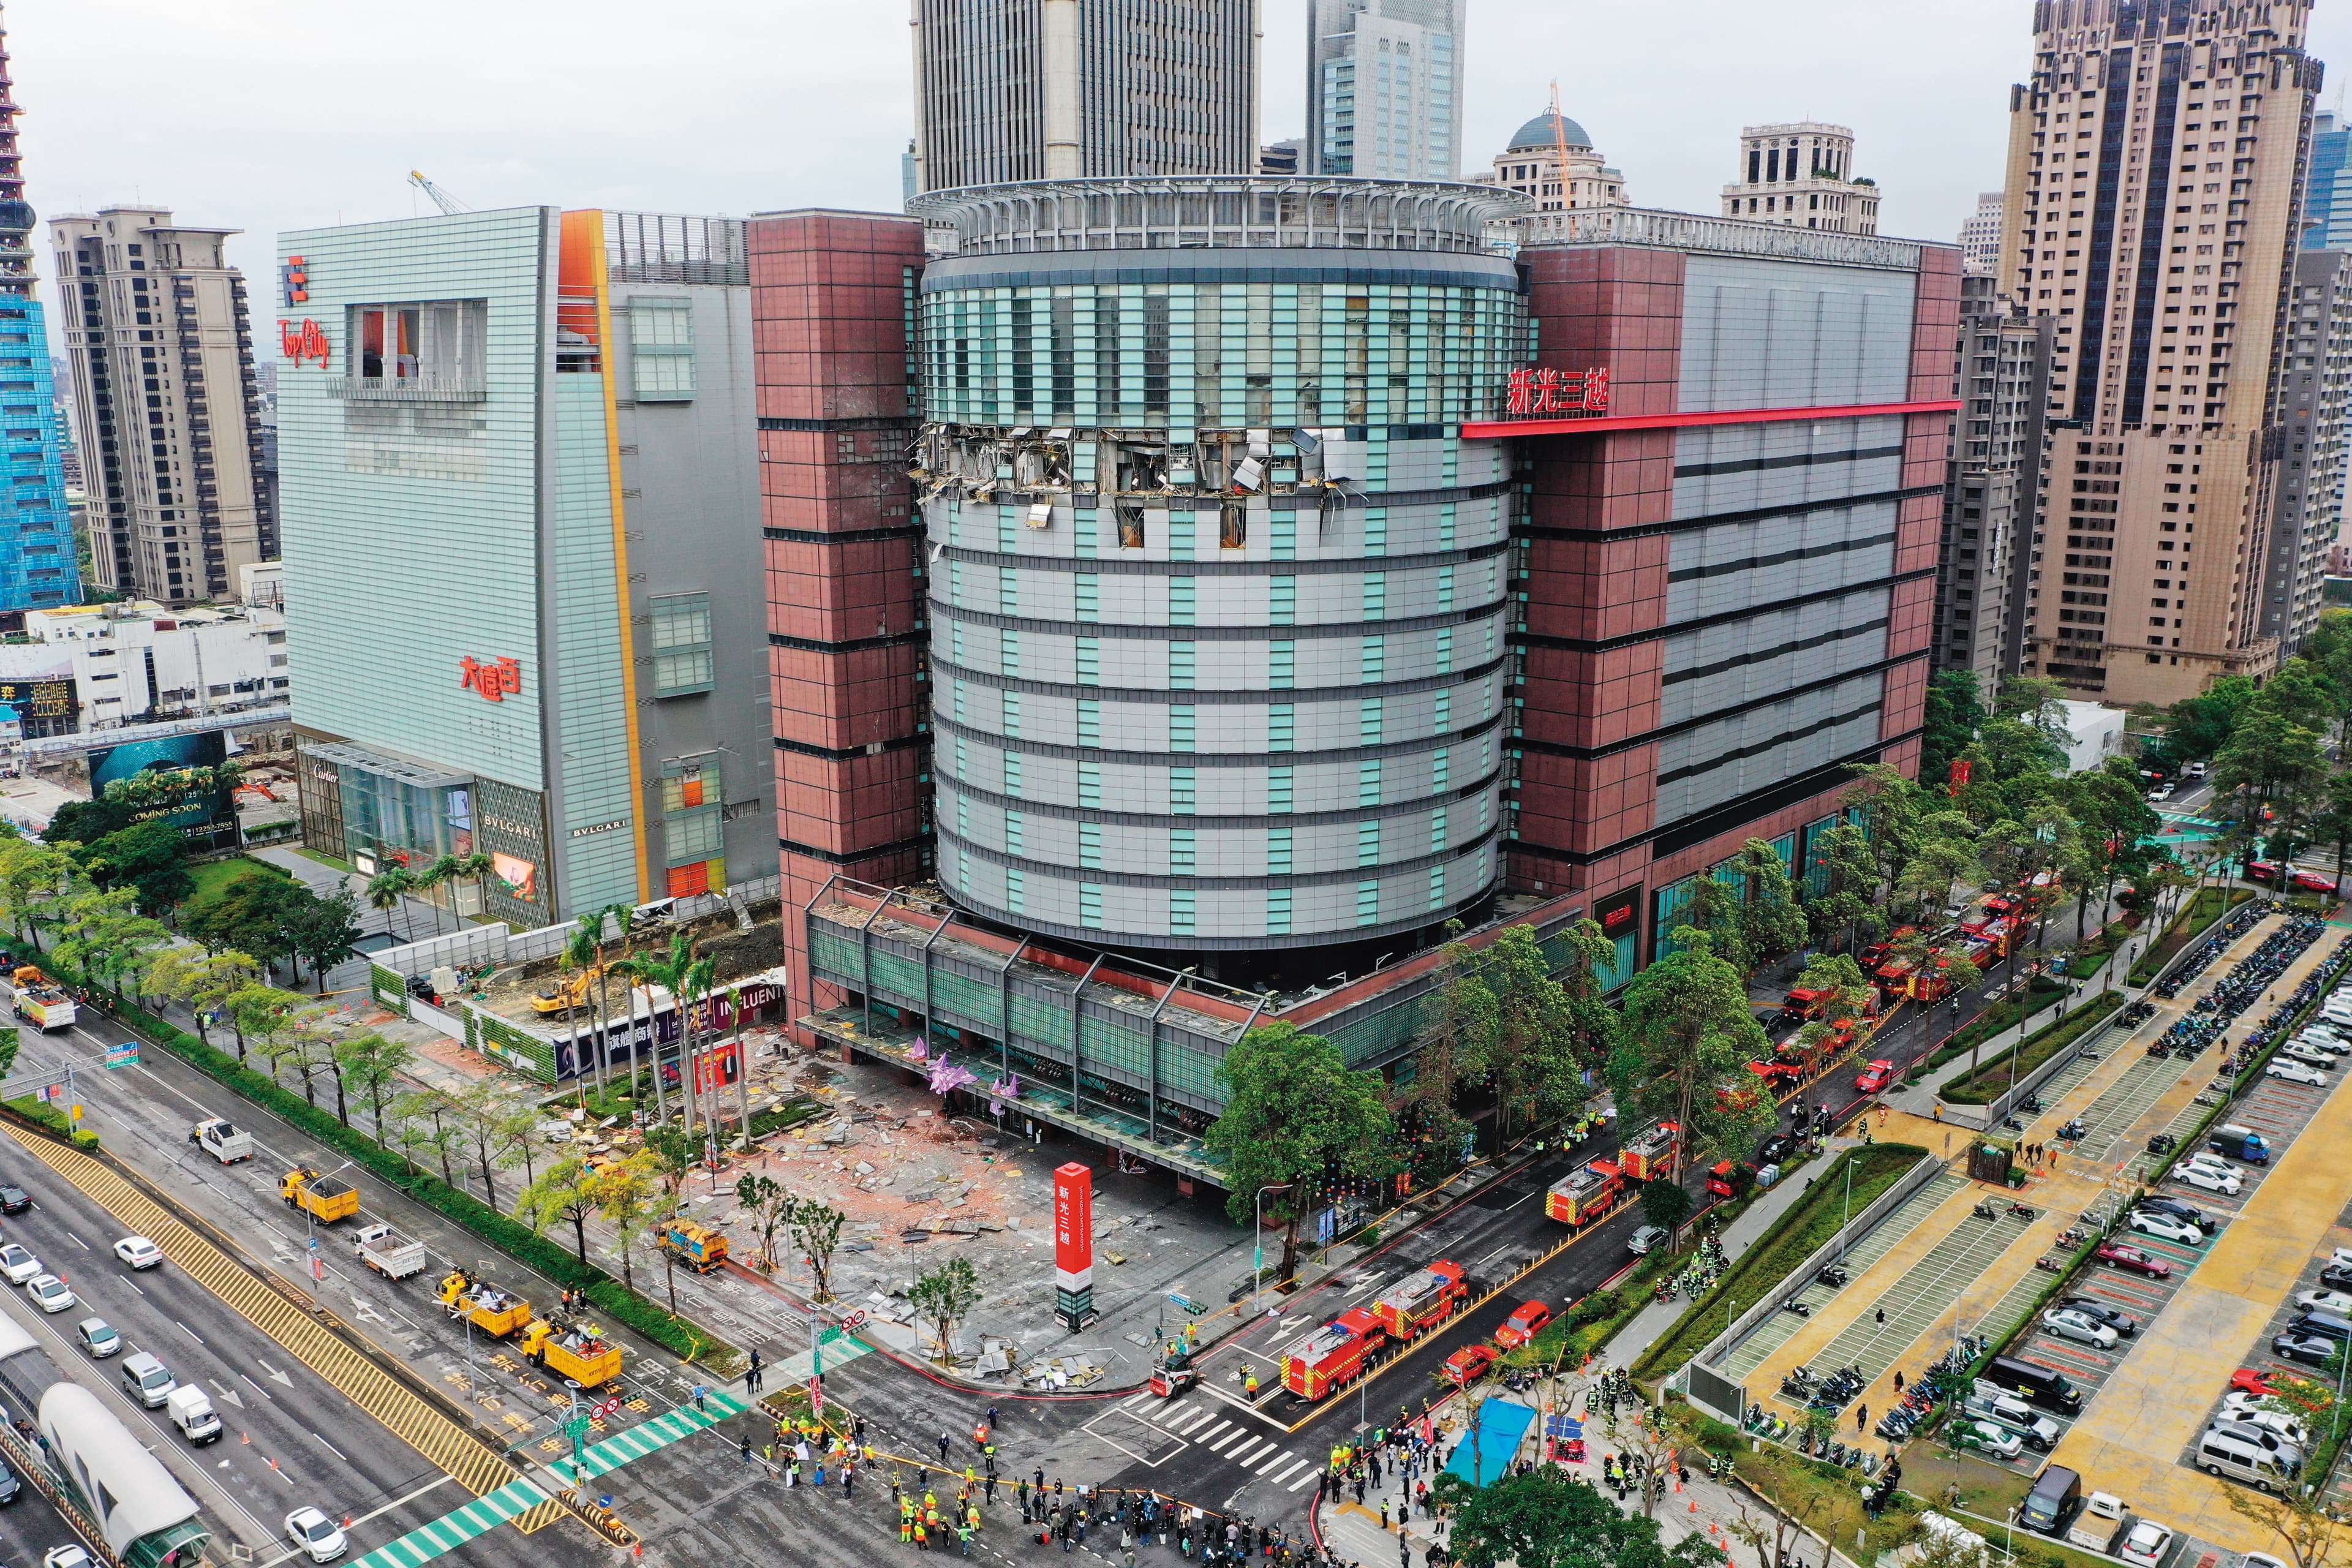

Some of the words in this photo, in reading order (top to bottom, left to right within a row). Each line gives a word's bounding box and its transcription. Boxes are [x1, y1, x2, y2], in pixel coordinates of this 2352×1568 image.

[1507, 368, 1610, 414] 新光三越
[459, 655, 520, 701] 大遠百
[314, 763, 339, 783] Cartier
[172, 802, 202, 815] SOON
[484, 815, 537, 840] BVLGARI
[573, 820, 626, 837] BVLGARI
[720, 984, 783, 1017] INLUENT
[1058, 1185, 1071, 1246] 新光三越
